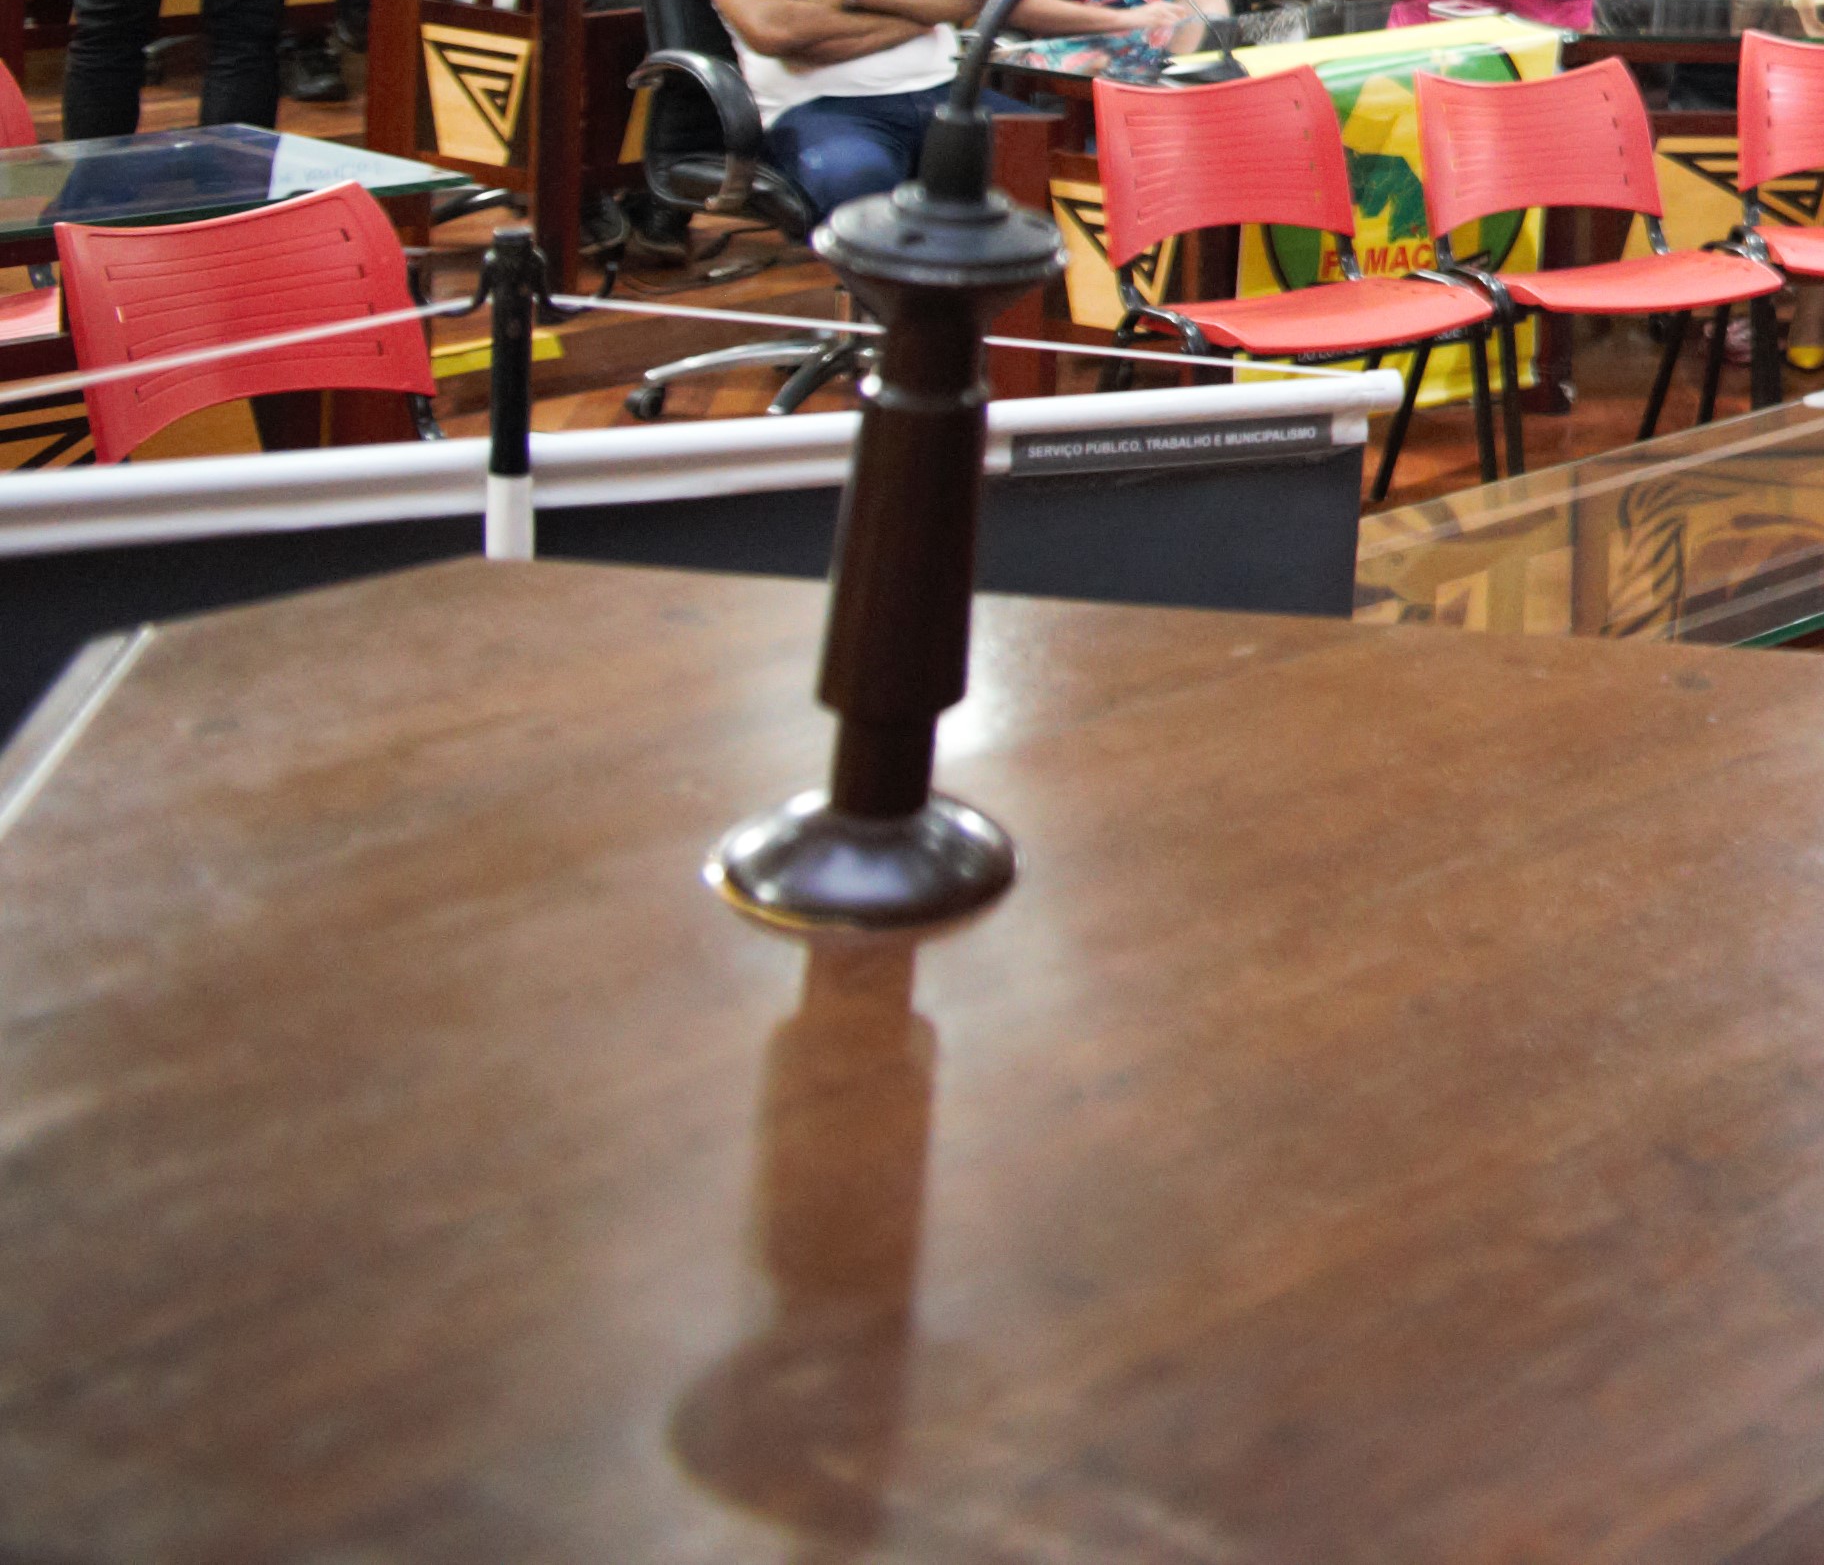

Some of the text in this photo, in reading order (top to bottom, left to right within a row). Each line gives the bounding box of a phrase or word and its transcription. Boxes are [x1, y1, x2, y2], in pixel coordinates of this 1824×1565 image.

[1028, 426, 1317, 460] SERVIÇO PÚBLICO, TRABALHO E MUNICIPALISMO
